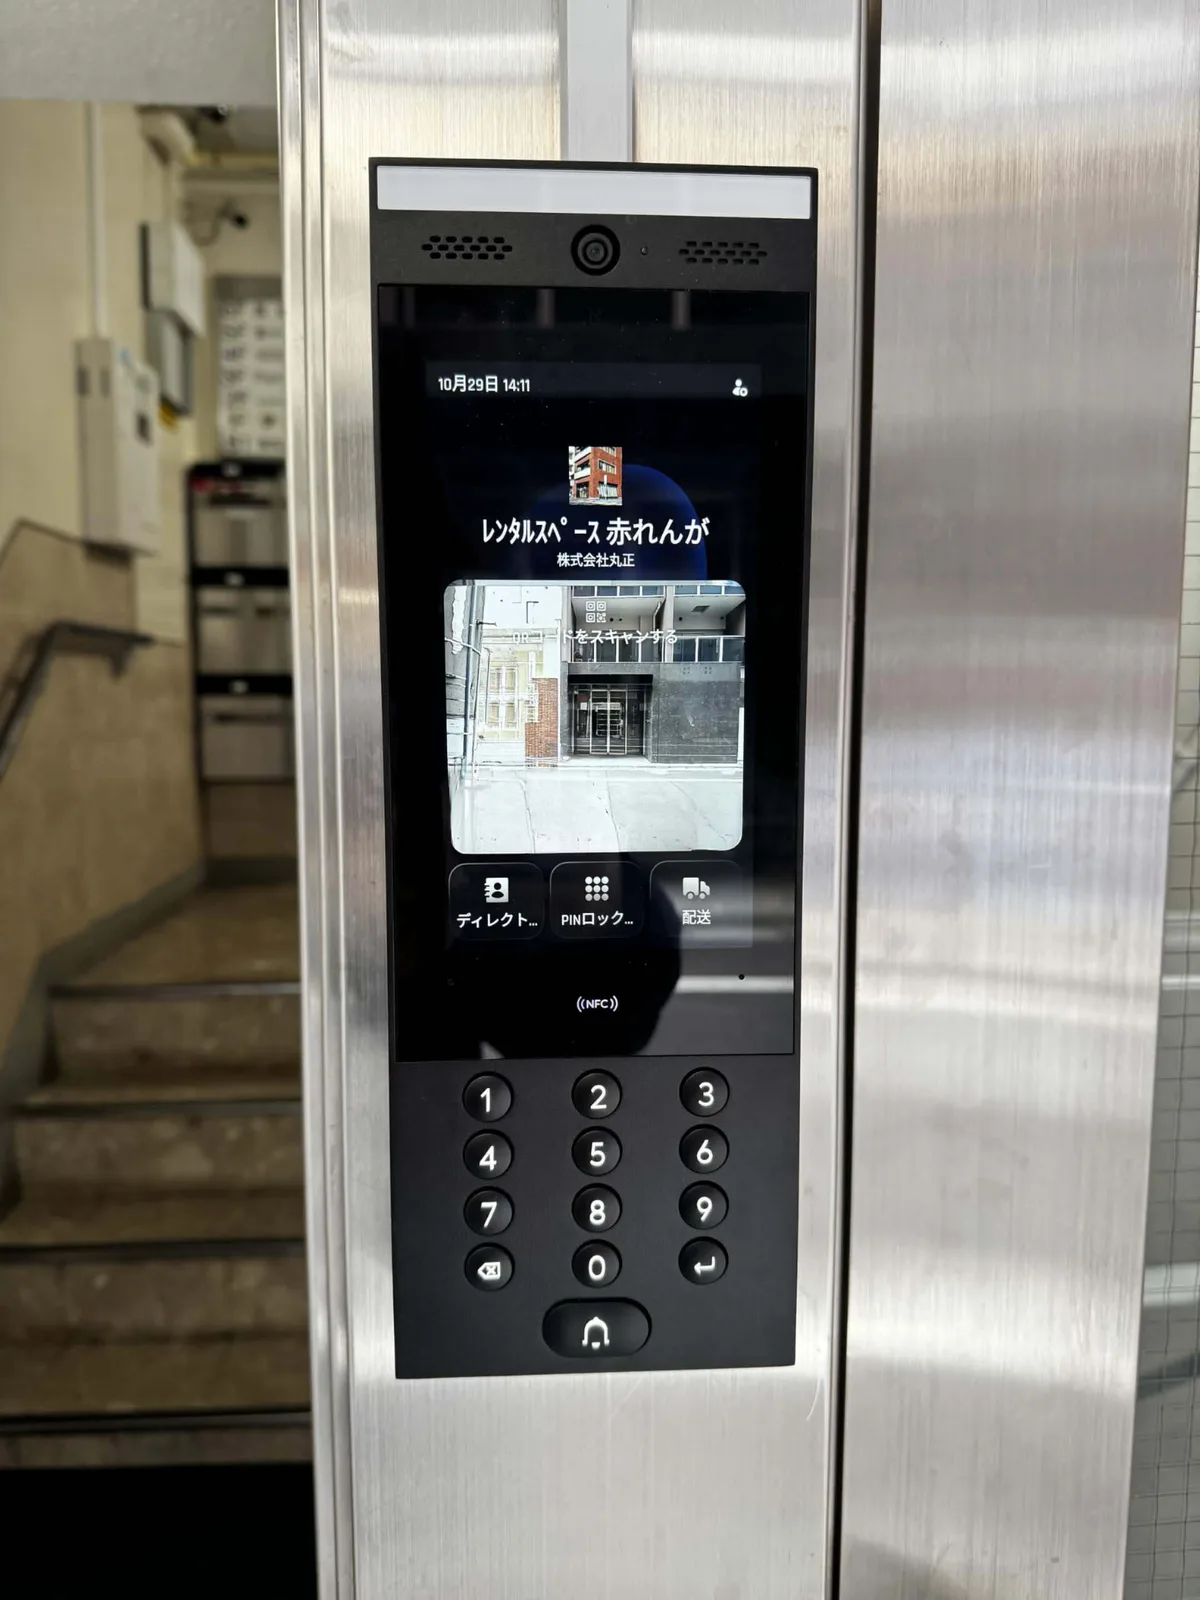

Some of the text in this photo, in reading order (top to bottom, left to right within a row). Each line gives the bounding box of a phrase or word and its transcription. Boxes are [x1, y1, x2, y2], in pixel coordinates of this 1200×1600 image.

[437, 374, 530, 393] 10月29日 14:11
[605, 517, 711, 546] 赤れんが
[556, 552, 636, 568] 株式会社丸正
[682, 909, 711, 925] 配送
[585, 998, 609, 1010] NFC
[480, 1081, 715, 1113] 1 2 3
[479, 1139, 714, 1171] 4 5 6
[480, 1196, 713, 1228] 7 8 9
[588, 1254, 606, 1281] 0
